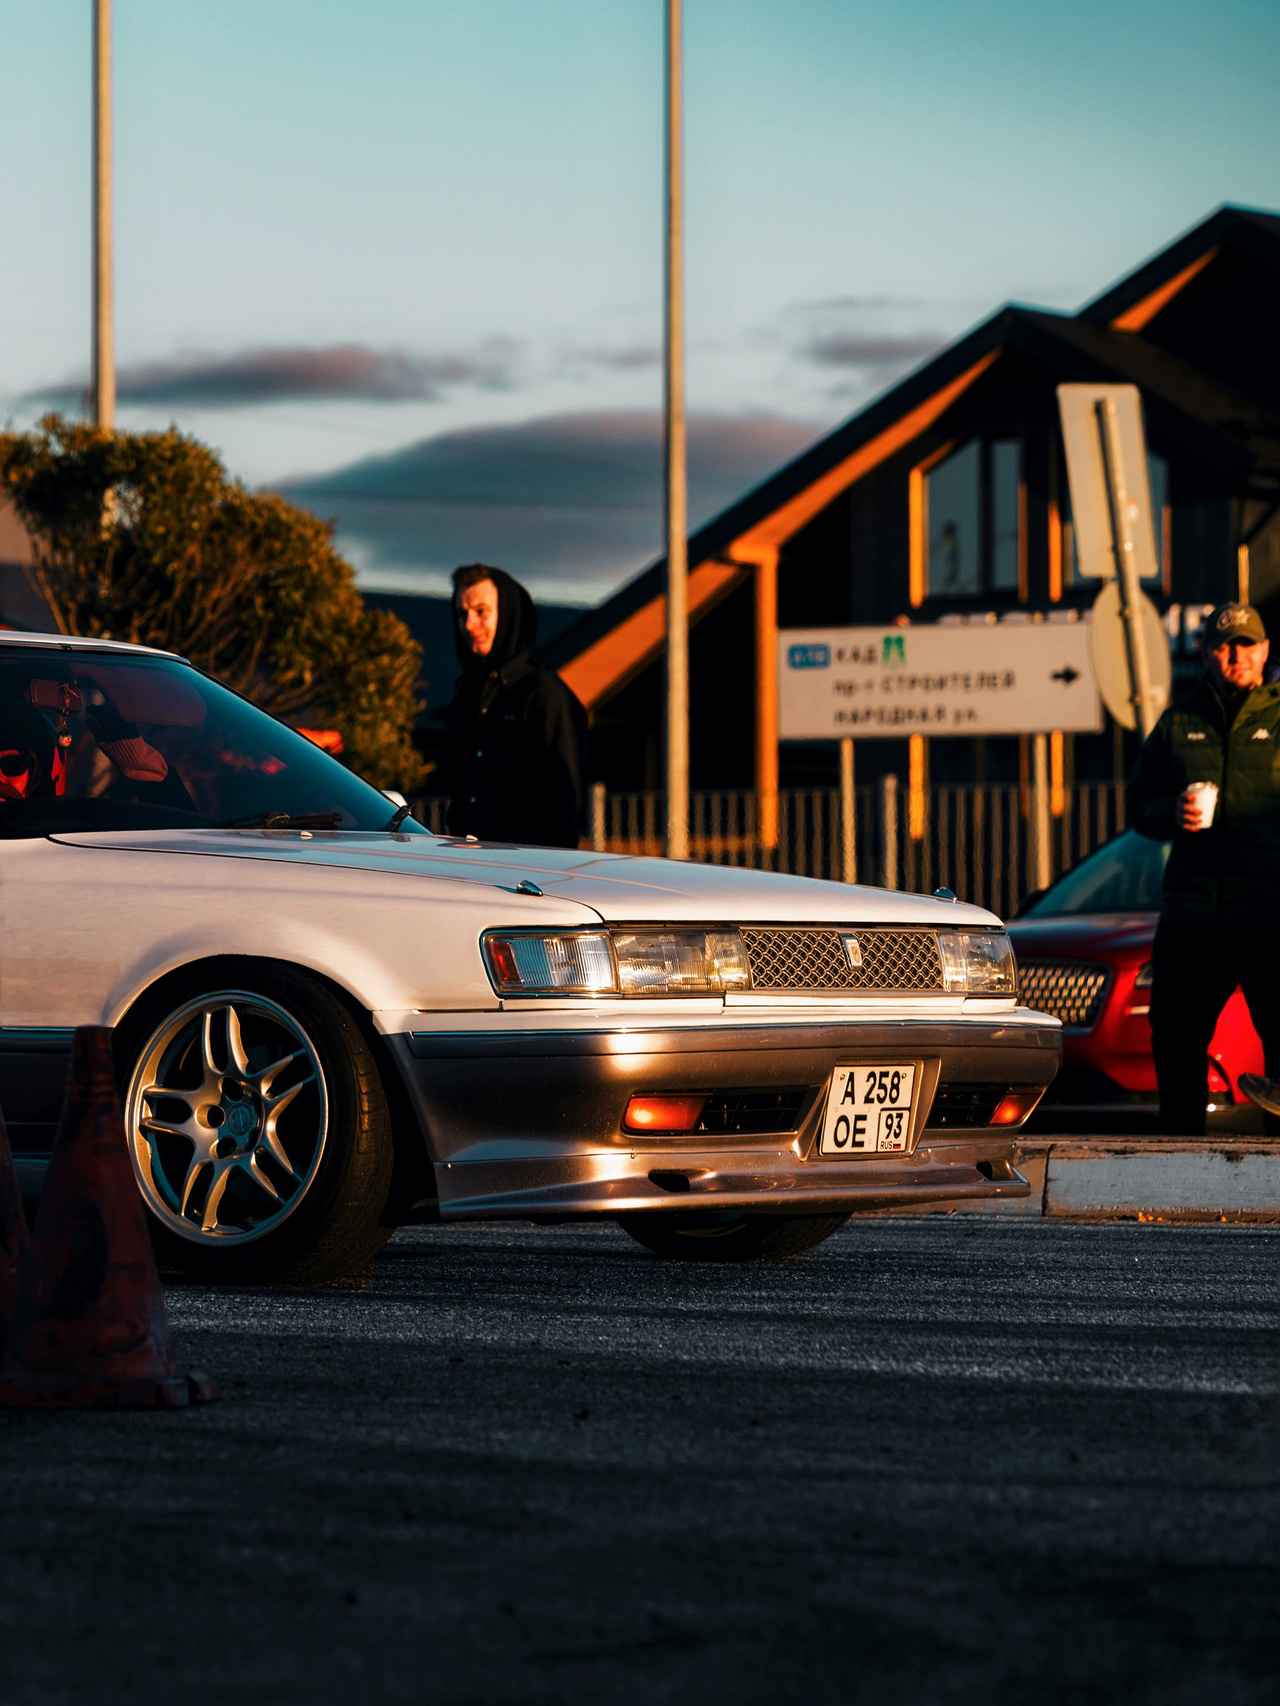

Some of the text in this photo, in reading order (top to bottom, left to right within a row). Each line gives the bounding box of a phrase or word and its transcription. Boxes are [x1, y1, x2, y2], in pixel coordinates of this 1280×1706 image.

[835, 646, 877, 665] КАД
[881, 669, 1015, 694] СТРОИТЕЛЕЙ
[834, 706, 946, 726] НАРОДНАЯ
[863, 1070, 901, 1104] 258
[885, 1112, 904, 1139] 93
[880, 1140, 893, 1150] RUS
